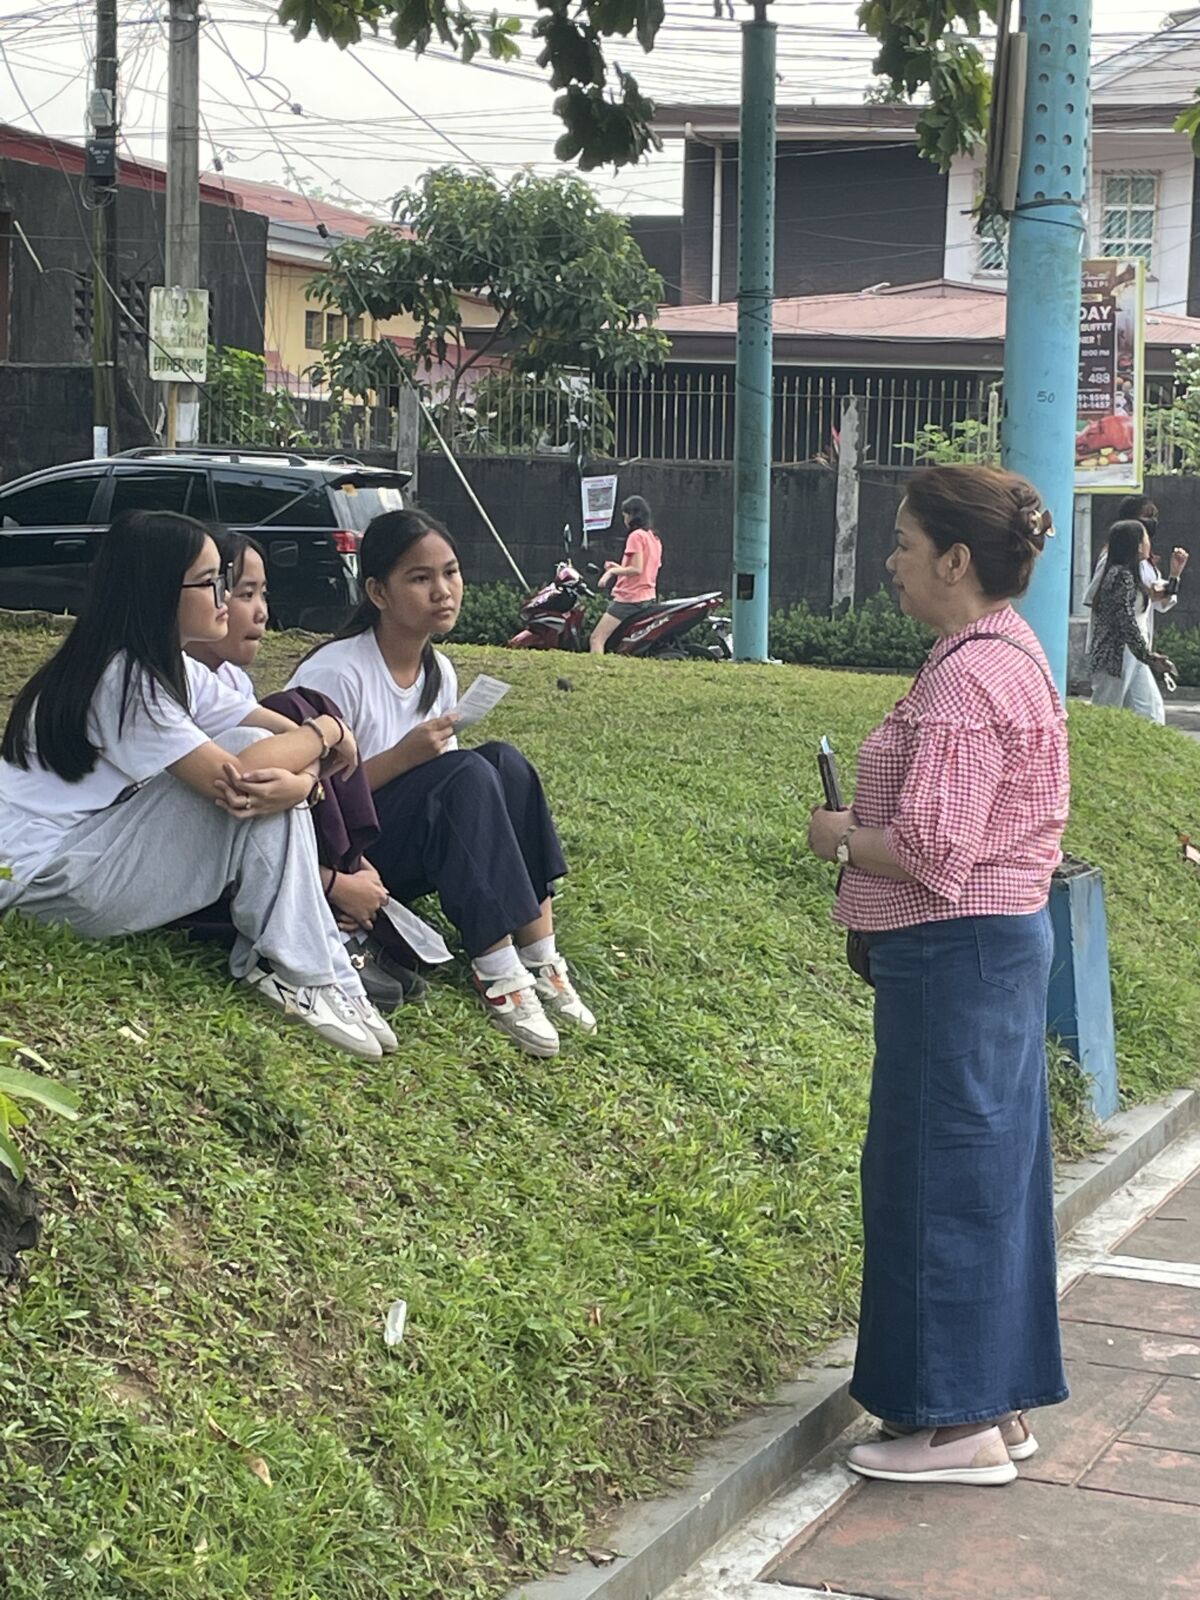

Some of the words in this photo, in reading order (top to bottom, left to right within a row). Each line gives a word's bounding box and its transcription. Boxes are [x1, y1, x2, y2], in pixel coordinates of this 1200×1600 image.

[1079, 305, 1112, 321] DAY
[153, 356, 184, 373] EITHER
[185, 357, 205, 374] SIDE
[1036, 390, 1056, 404] 50
